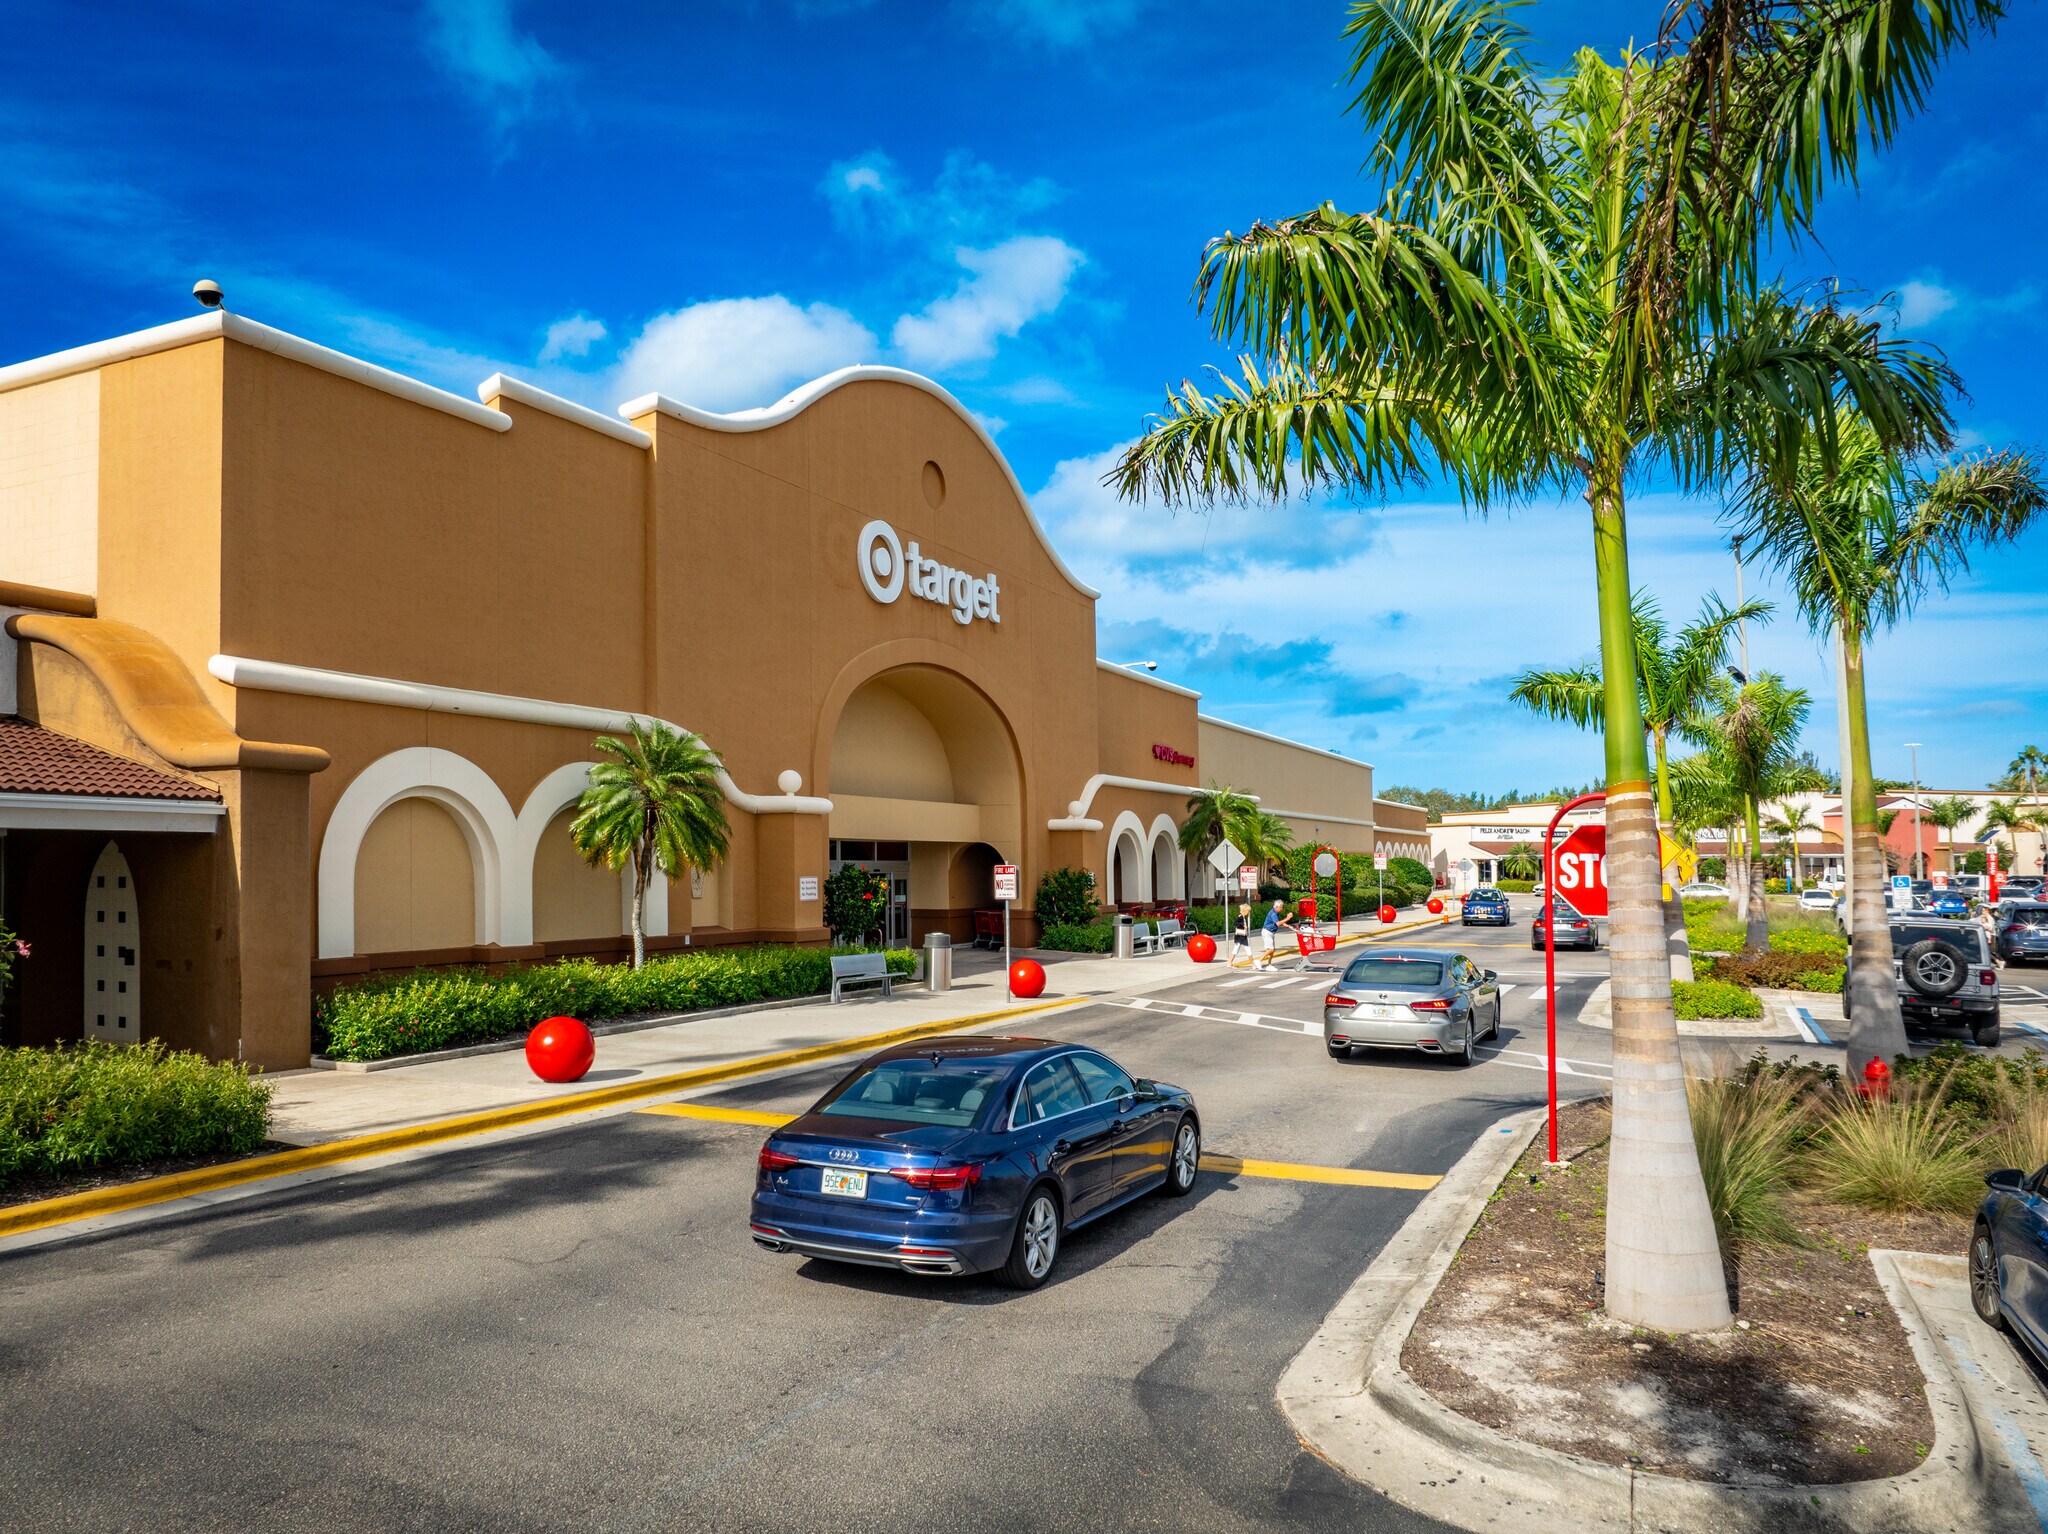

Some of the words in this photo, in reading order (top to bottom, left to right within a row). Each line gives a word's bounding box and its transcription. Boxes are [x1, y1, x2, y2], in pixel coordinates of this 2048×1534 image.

[905, 541, 1000, 625] target
[996, 880, 1003, 889] NO
[848, 1177, 864, 1191] ENU
